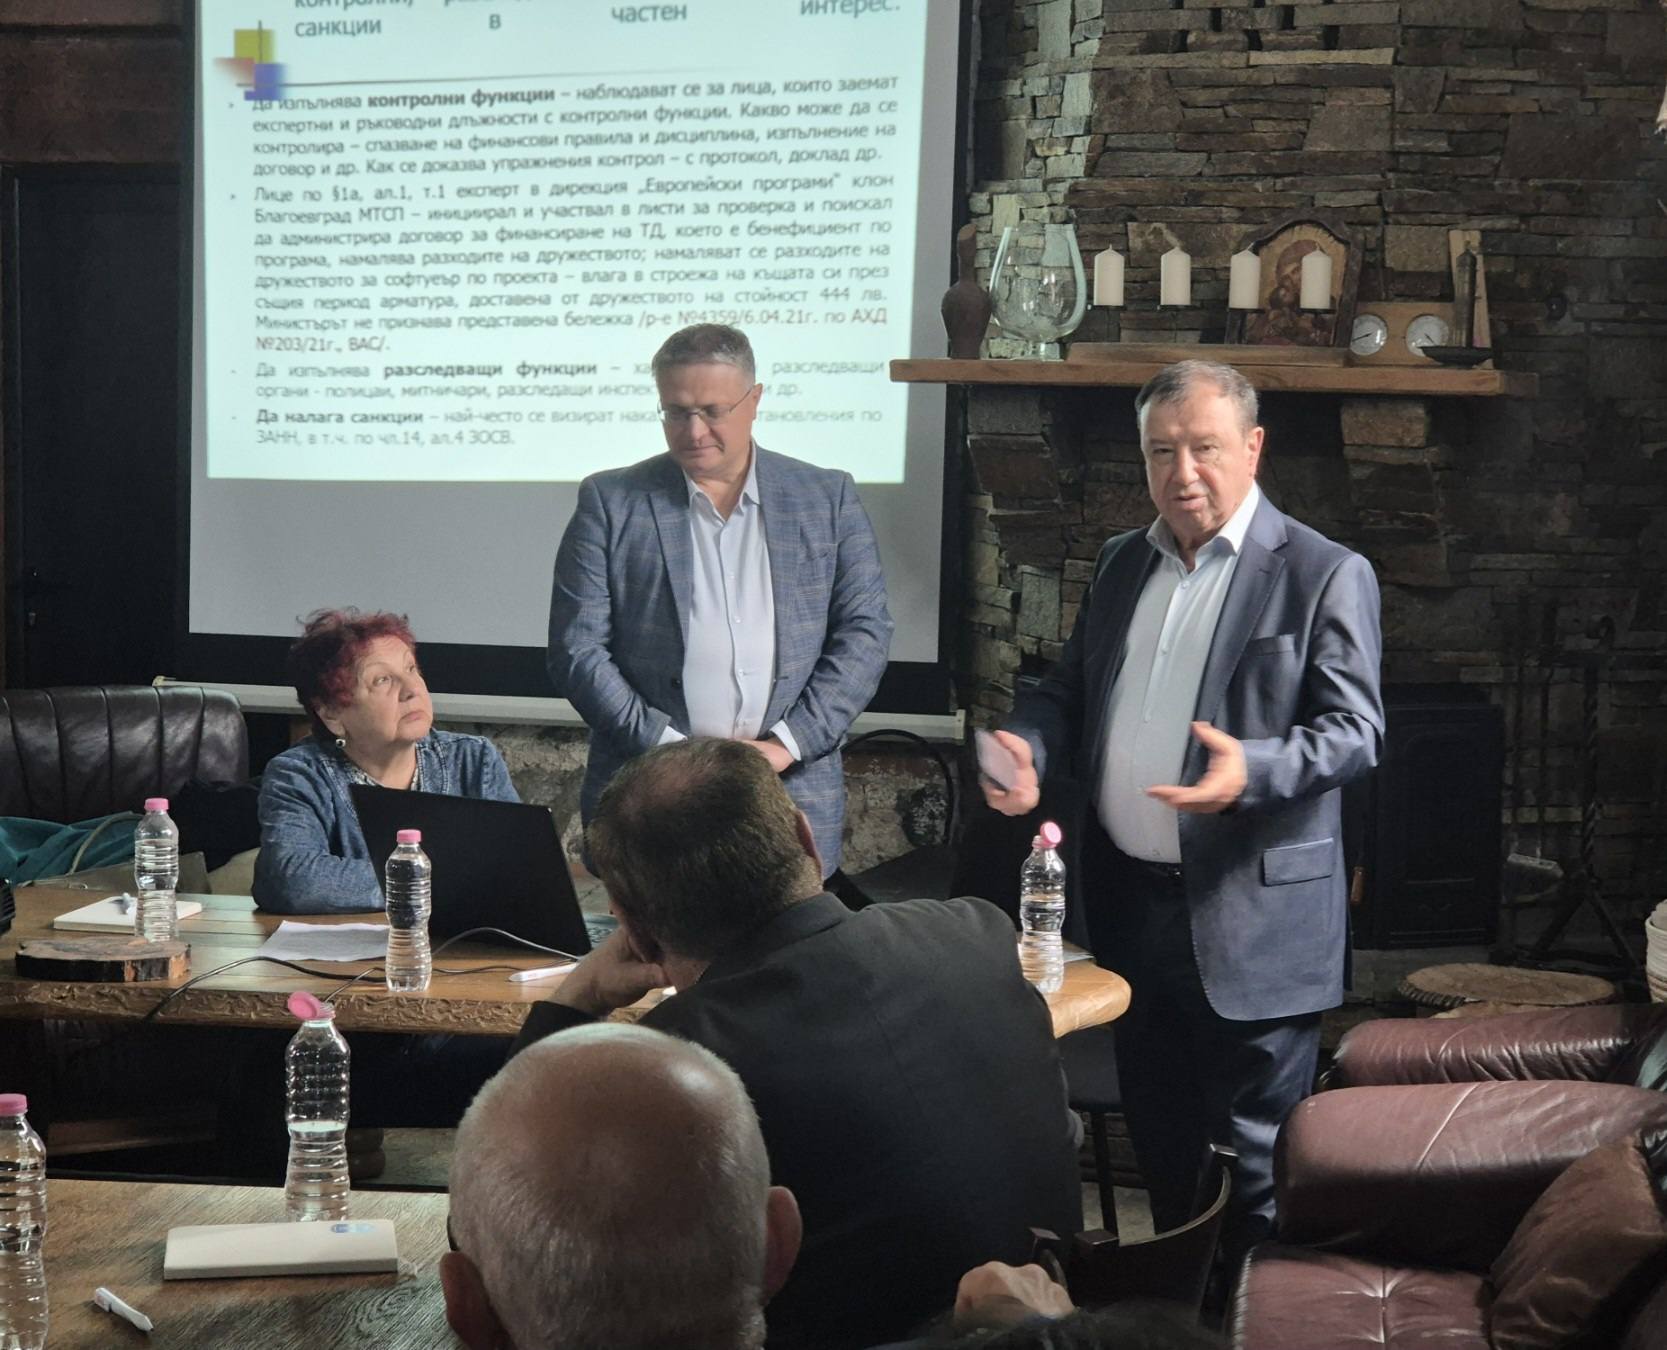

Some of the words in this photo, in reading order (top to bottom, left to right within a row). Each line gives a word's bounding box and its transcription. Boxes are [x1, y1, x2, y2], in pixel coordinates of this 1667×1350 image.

[294, 19, 382, 37] санкции
[489, 14, 502, 29] в
[611, 3, 688, 23] частен
[800, 0, 900, 18] интерес.
[278, 96, 362, 110] изпълнява
[368, 94, 466, 110] контролни
[471, 89, 556, 107] функции
[577, 83, 677, 100] наблюдават
[683, 84, 702, 97] се
[707, 83, 726, 95] за
[784, 80, 833, 93] които
[839, 76, 898, 92] заемат
[253, 120, 334, 135] експертни
[340, 120, 351, 130] и
[356, 117, 443, 133] ръководни
[448, 113, 539, 129] длъжности
[544, 112, 553, 124] с
[560, 109, 648, 125] контролни
[740, 102, 791, 117] Какво
[797, 104, 843, 115] може
[849, 102, 871, 116] да
[878, 100, 898, 113] се
[254, 142, 345, 156] контролира
[365, 140, 438, 152] спазване
[444, 138, 464, 150] на
[468, 135, 560, 152] финансови
[564, 132, 634, 149] правила
[639, 133, 650, 143] и
[767, 126, 870, 140] изпълнение
[875, 124, 897, 136] на
[253, 164, 317, 178] договор
[321, 165, 331, 174] и
[366, 159, 395, 174] Как
[399, 162, 418, 173] се
[422, 159, 487, 174] доказва
[492, 156, 593, 173] упражнения
[597, 153, 665, 169] контрол
[685, 152, 694, 165] с
[788, 149, 850, 164] доклад
[254, 187, 294, 202] Лице
[303, 190, 323, 202] по
[424, 184, 446, 199] т.1
[456, 184, 520, 199] експерт
[530, 184, 541, 196] в
[549, 182, 629, 197] дирекция
[852, 175, 894, 188] клон
[255, 208, 353, 226] Благоевград
[359, 206, 405, 222] МТСП
[428, 207, 517, 221] инициирал
[523, 207, 534, 218] и
[541, 205, 615, 221] участвал
[621, 204, 631, 217] в
[638, 203, 686, 215] листи
[693, 203, 711, 215] за
[718, 201, 797, 216] проверка
[804, 202, 815, 212] и
[822, 198, 893, 212] поискал
[254, 234, 274, 246] да
[280, 233, 392, 246] администрира
[398, 230, 464, 245] договор
[472, 230, 489, 241] за
[495, 227, 606, 243] финансиране
[612, 227, 633, 239] на
[676, 225, 723, 238] което
[730, 225, 741, 237] е
[747, 220, 862, 238] бенефициент
[871, 221, 893, 233] по
[339, 254, 416, 266] намалява
[422, 251, 505, 266] разходите
[511, 251, 531, 263] на
[654, 247, 742, 260] намаляват
[749, 247, 768, 258] се
[774, 245, 863, 260] разходите
[870, 244, 891, 256] на
[255, 276, 355, 290] дружеството
[361, 275, 378, 287] за
[467, 273, 488, 285] по
[493, 272, 559, 286] проекта
[582, 271, 628, 283] влага
[634, 271, 644, 282] в
[650, 270, 719, 284] строежа
[726, 269, 747, 280] на
[754, 268, 815, 282] къщата
[822, 268, 842, 279] си
[849, 266, 890, 280] през
[314, 298, 372, 311] период
[469, 294, 552, 308] доставена
[561, 293, 580, 305] от
[589, 293, 695, 308] дружеството
[705, 292, 725, 303] на
[735, 287, 809, 303] стойност
[820, 288, 851, 301] 444
[256, 316, 348, 331] Министърът
[354, 319, 374, 329] не
[379, 317, 453, 331] признава
[458, 316, 559, 330] представена
[564, 311, 634, 327] бележка
[825, 312, 846, 324] по
[851, 307, 888, 324] АХД
[256, 362, 276, 378] Да
[289, 366, 371, 378] изпълнява
[384, 365, 503, 380] разследващи
[516, 361, 598, 378] функции
[771, 362, 885, 376] разследващи
[256, 386, 310, 399] органи
[256, 409, 280, 424] Да
[285, 413, 345, 424] налага
[350, 413, 424, 424] санкции
[528, 412, 546, 423] се
[552, 411, 614, 424] визират
[863, 411, 882, 422] по
[308, 434, 318, 445] в
[355, 434, 375, 445] по
